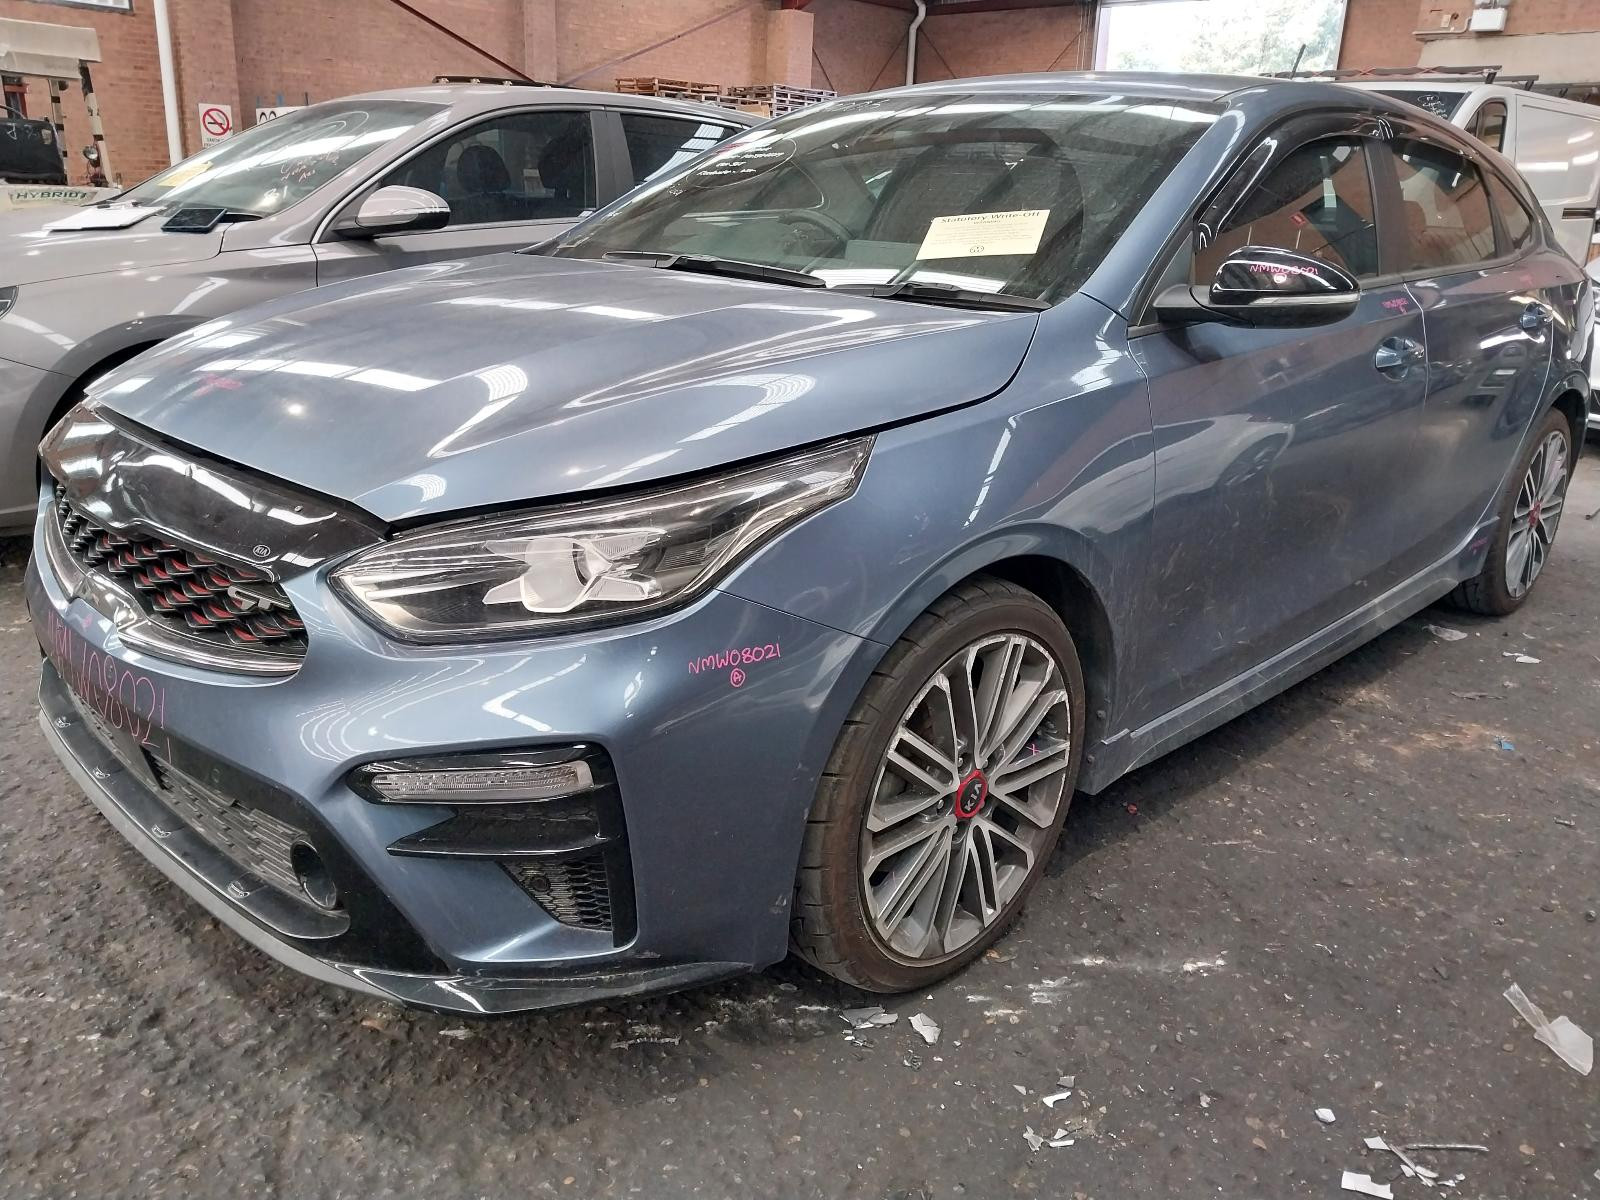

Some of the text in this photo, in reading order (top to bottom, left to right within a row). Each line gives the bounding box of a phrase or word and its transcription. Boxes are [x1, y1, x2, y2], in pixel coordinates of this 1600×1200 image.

[941, 214, 988, 224] Statutory
[991, 211, 1040, 220] Write-Off
[254, 546, 268, 556] KIA
[688, 642, 782, 674] NMW08021
[964, 782, 983, 812] KIA
